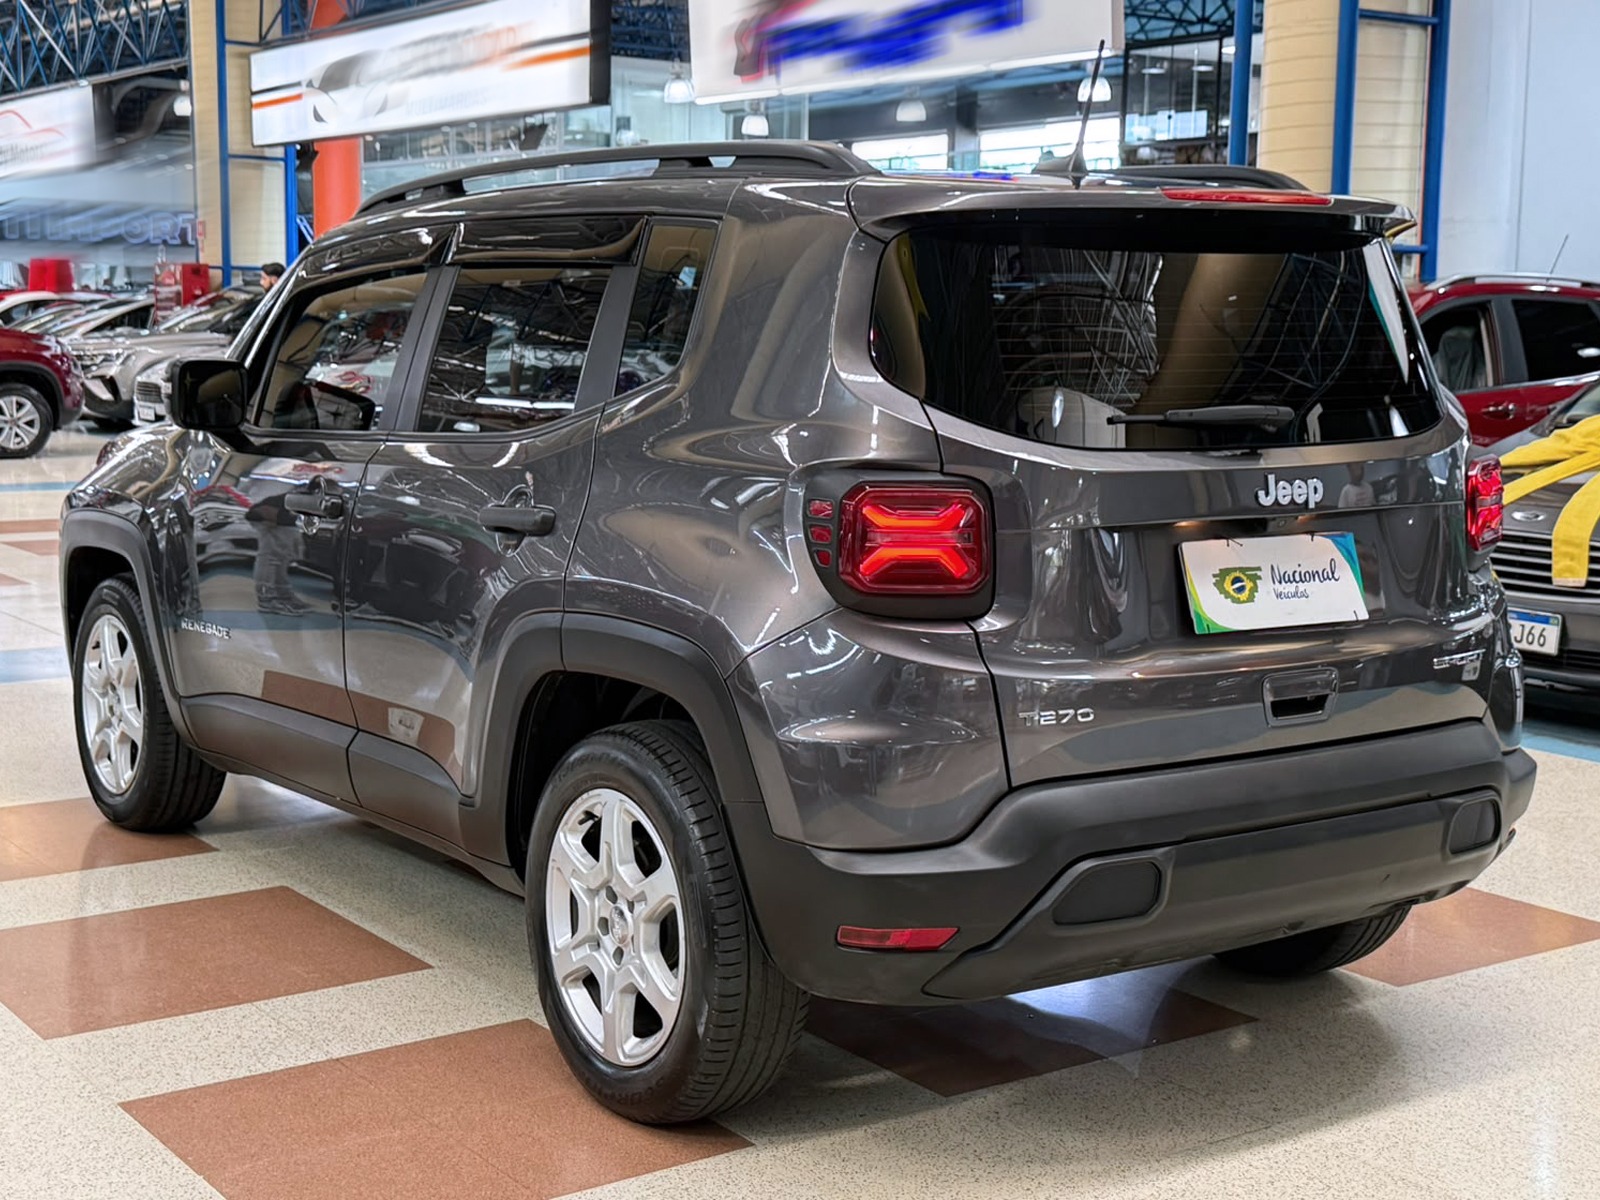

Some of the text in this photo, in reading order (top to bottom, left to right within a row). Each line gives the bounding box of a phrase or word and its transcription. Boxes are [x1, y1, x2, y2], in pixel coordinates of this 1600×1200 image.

[1257, 473, 1324, 509] Jeep
[1270, 558, 1340, 585] Nacional
[181, 617, 230, 639] RENEGADE
[1513, 623, 1546, 647] J66
[1018, 707, 1094, 726] T270
